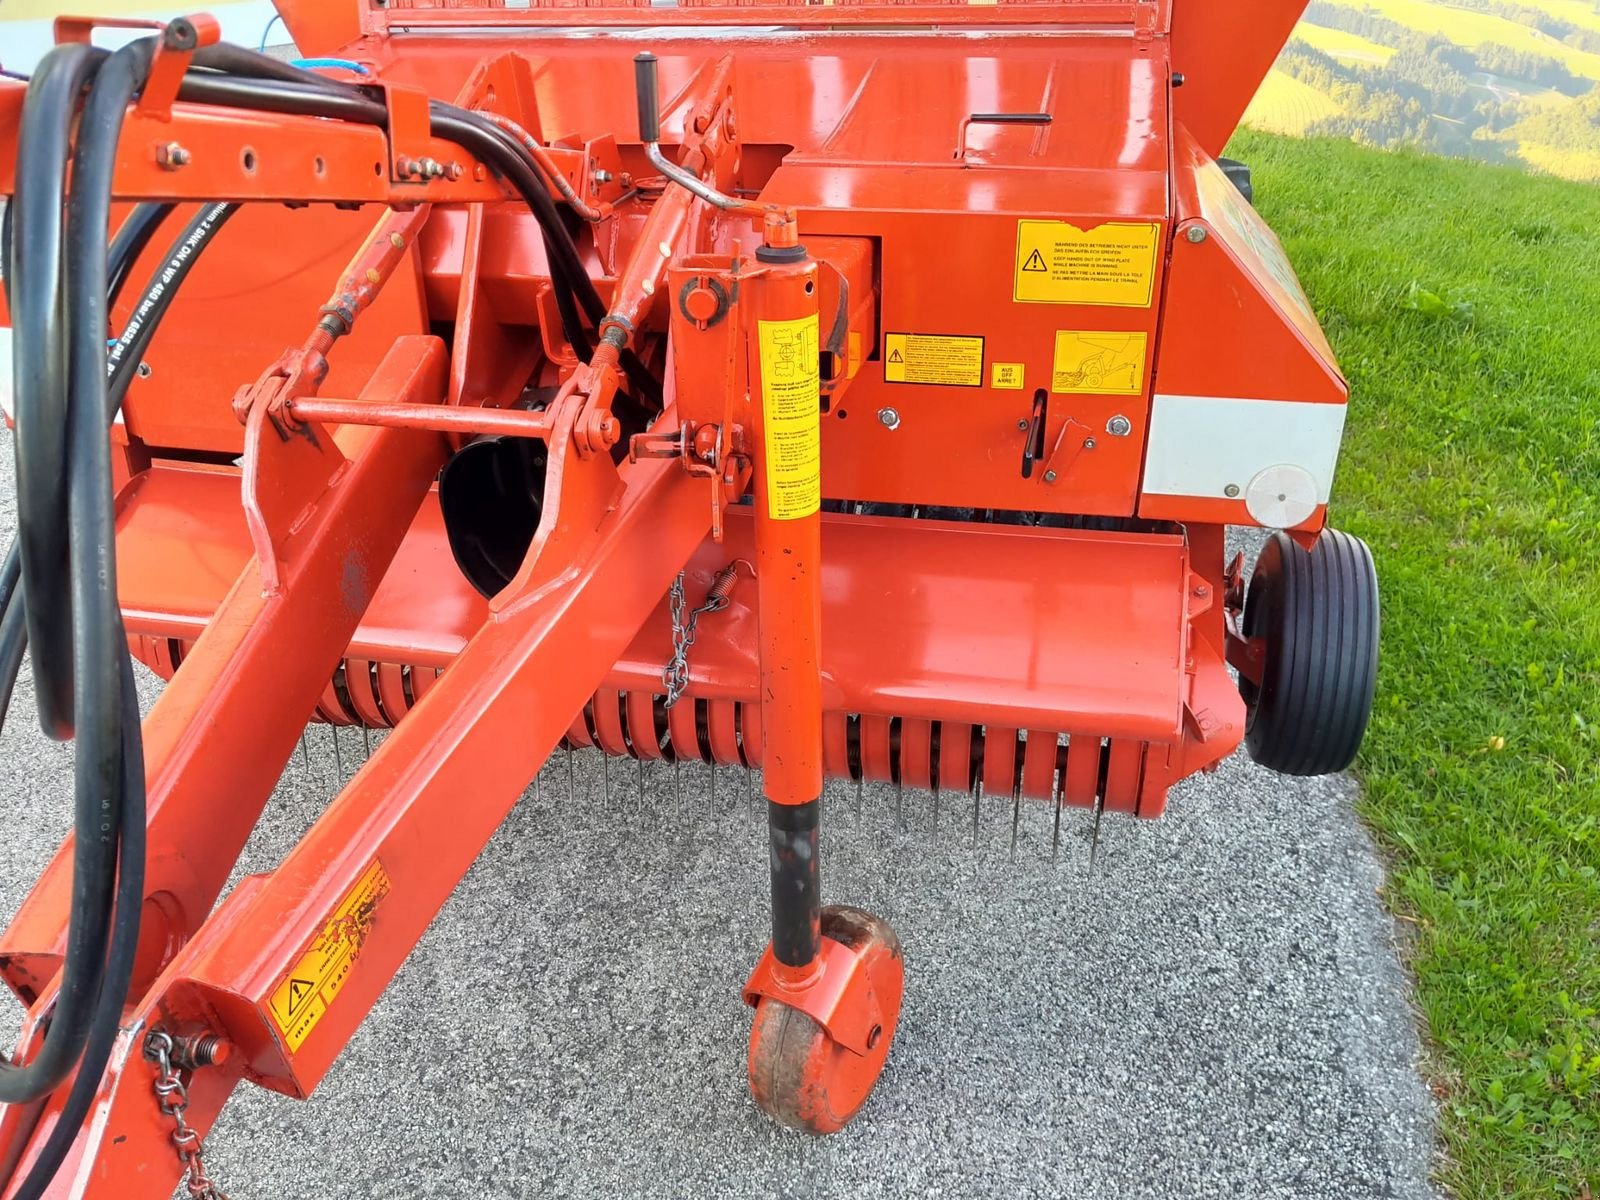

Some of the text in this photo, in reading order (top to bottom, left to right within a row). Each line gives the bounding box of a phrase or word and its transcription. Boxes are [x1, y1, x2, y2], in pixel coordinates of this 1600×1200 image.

[201, 221, 211, 229] 2
[186, 227, 206, 247] SNK
[176, 245, 192, 261] DN
[171, 259, 181, 268] 6
[162, 267, 177, 284] WP
[148, 282, 165, 301] 450
[139, 299, 155, 317] bar
[121, 320, 140, 345] 6525
[330, 964, 349, 990] 540
